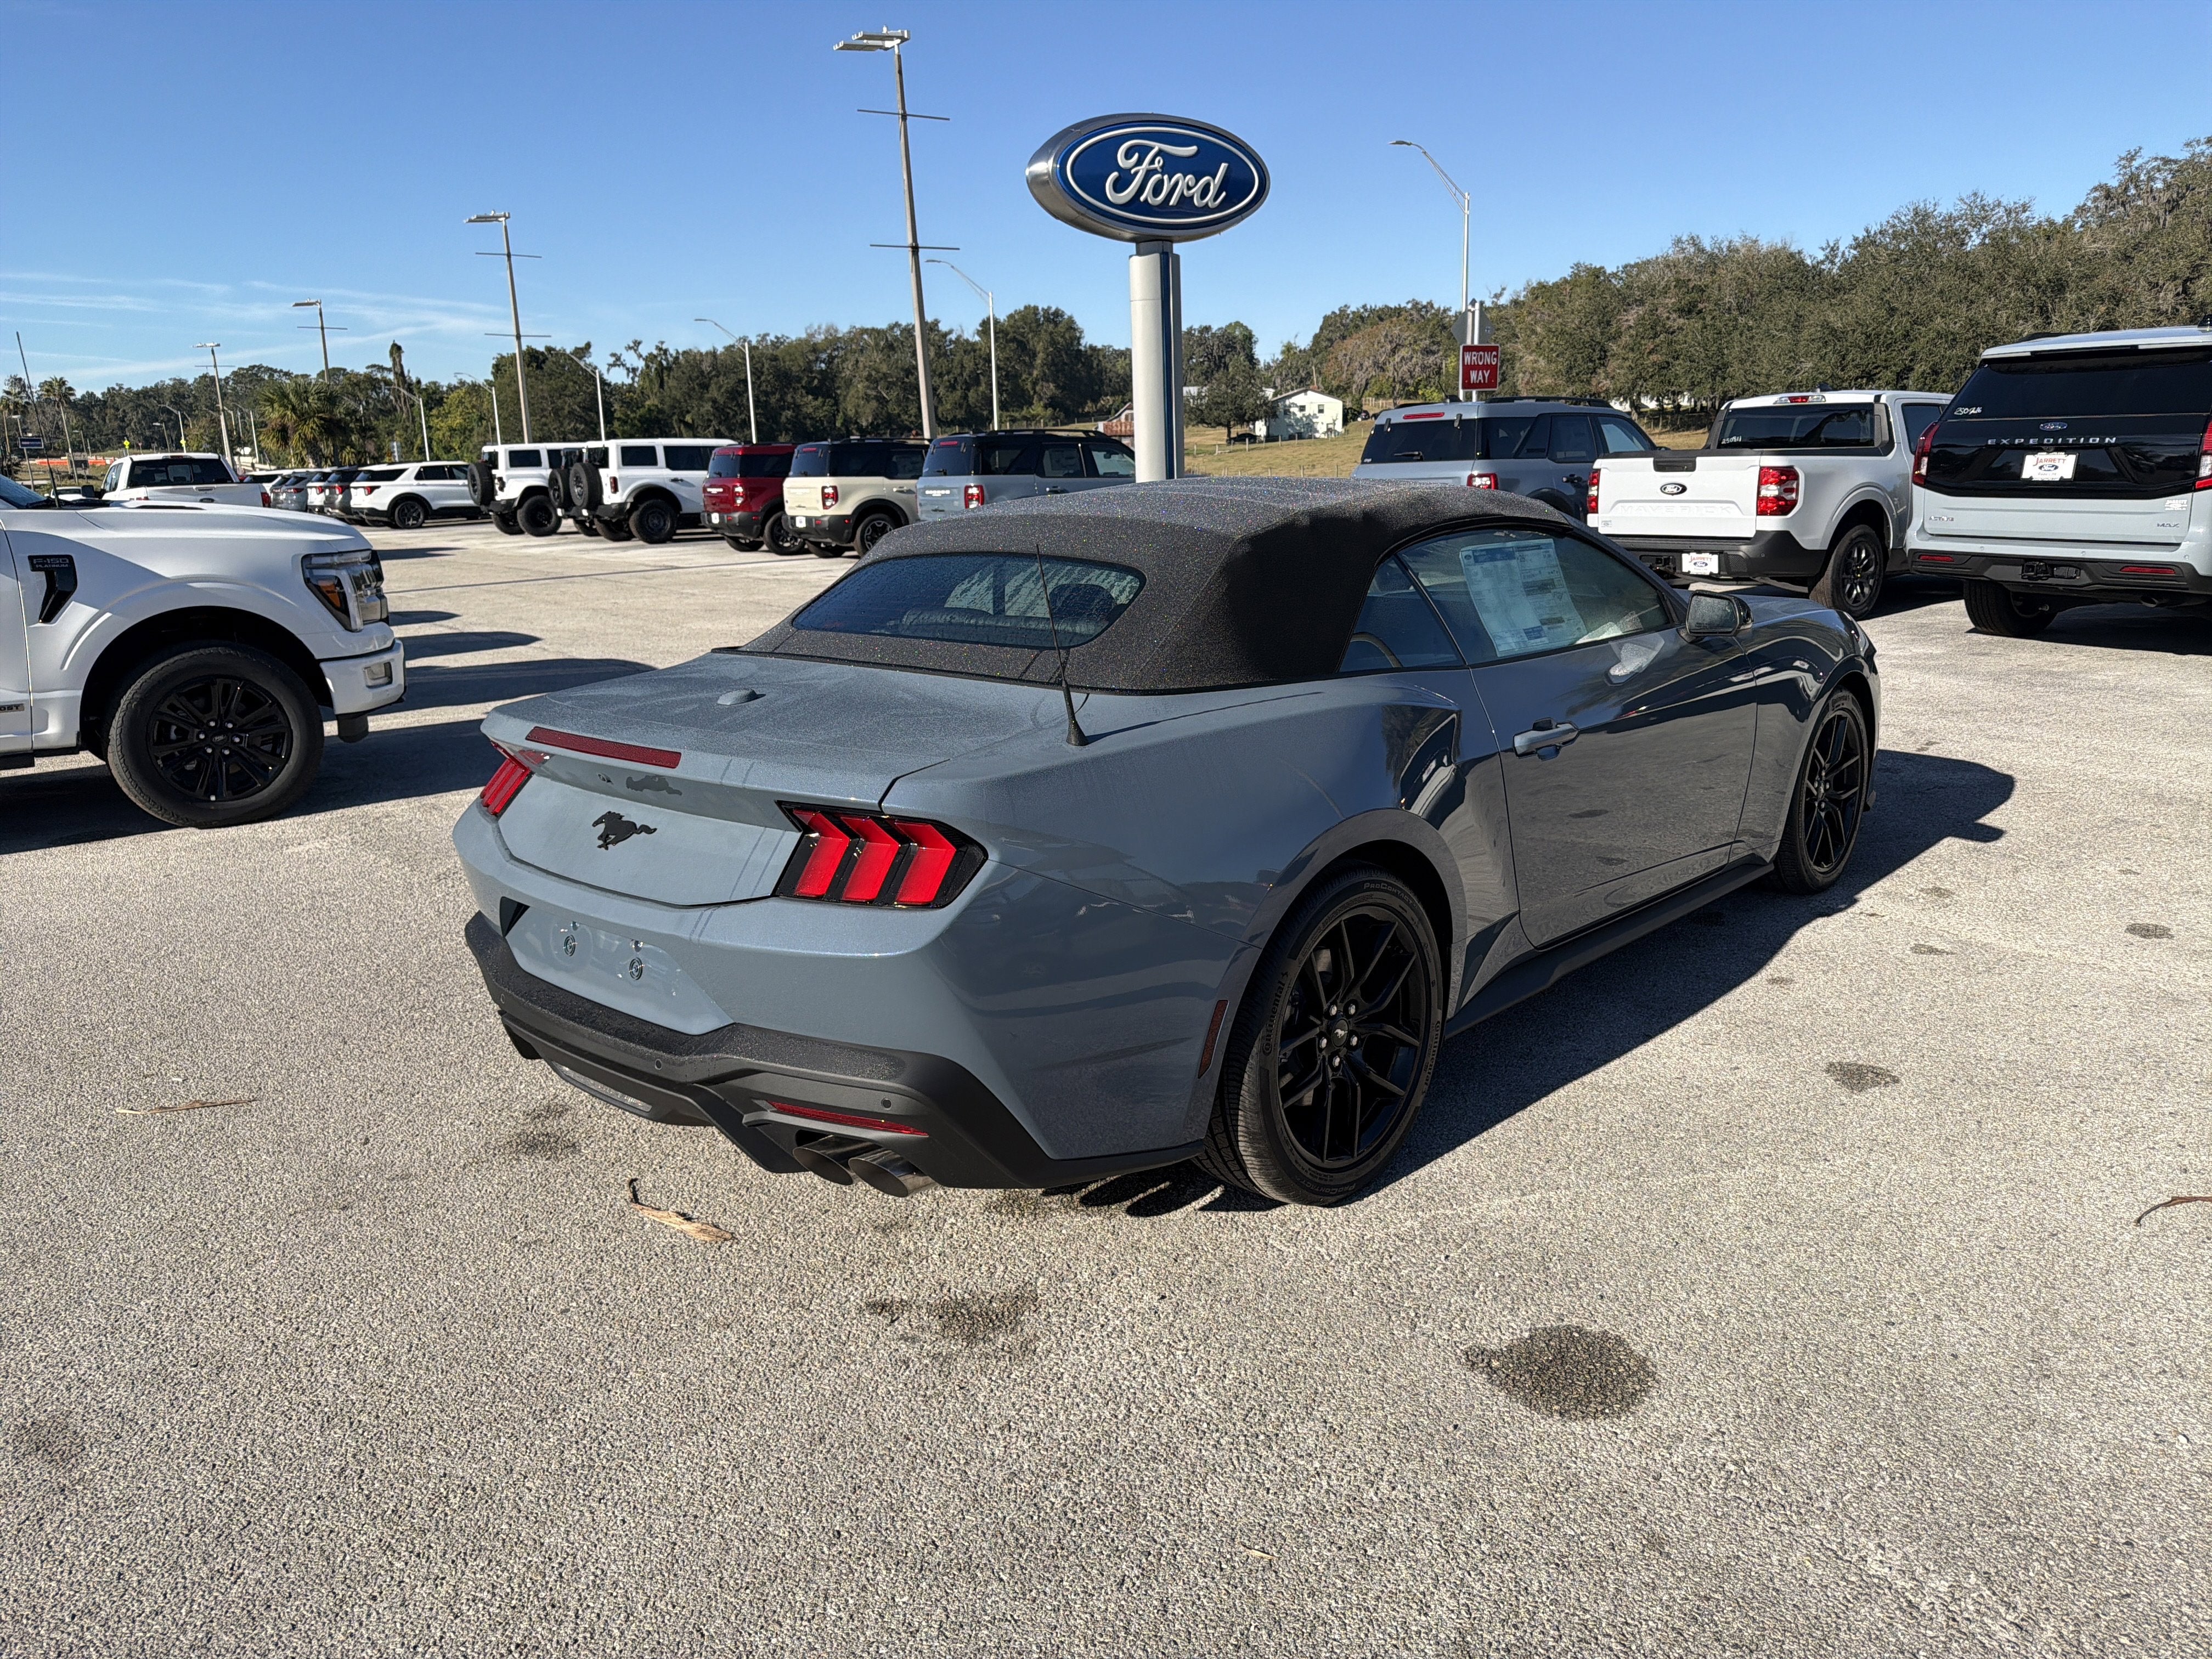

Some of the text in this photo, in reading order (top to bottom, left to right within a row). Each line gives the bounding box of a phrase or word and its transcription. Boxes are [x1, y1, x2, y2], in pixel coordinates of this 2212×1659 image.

[1105, 139, 1229, 208] Ford
[1464, 351, 1497, 365] WRONG
[1470, 370, 1491, 383] WAY
[2033, 458, 2066, 466] JARRETT
[1620, 505, 1731, 515] MAVERICK
[1262, 980, 1285, 1056] Continental
